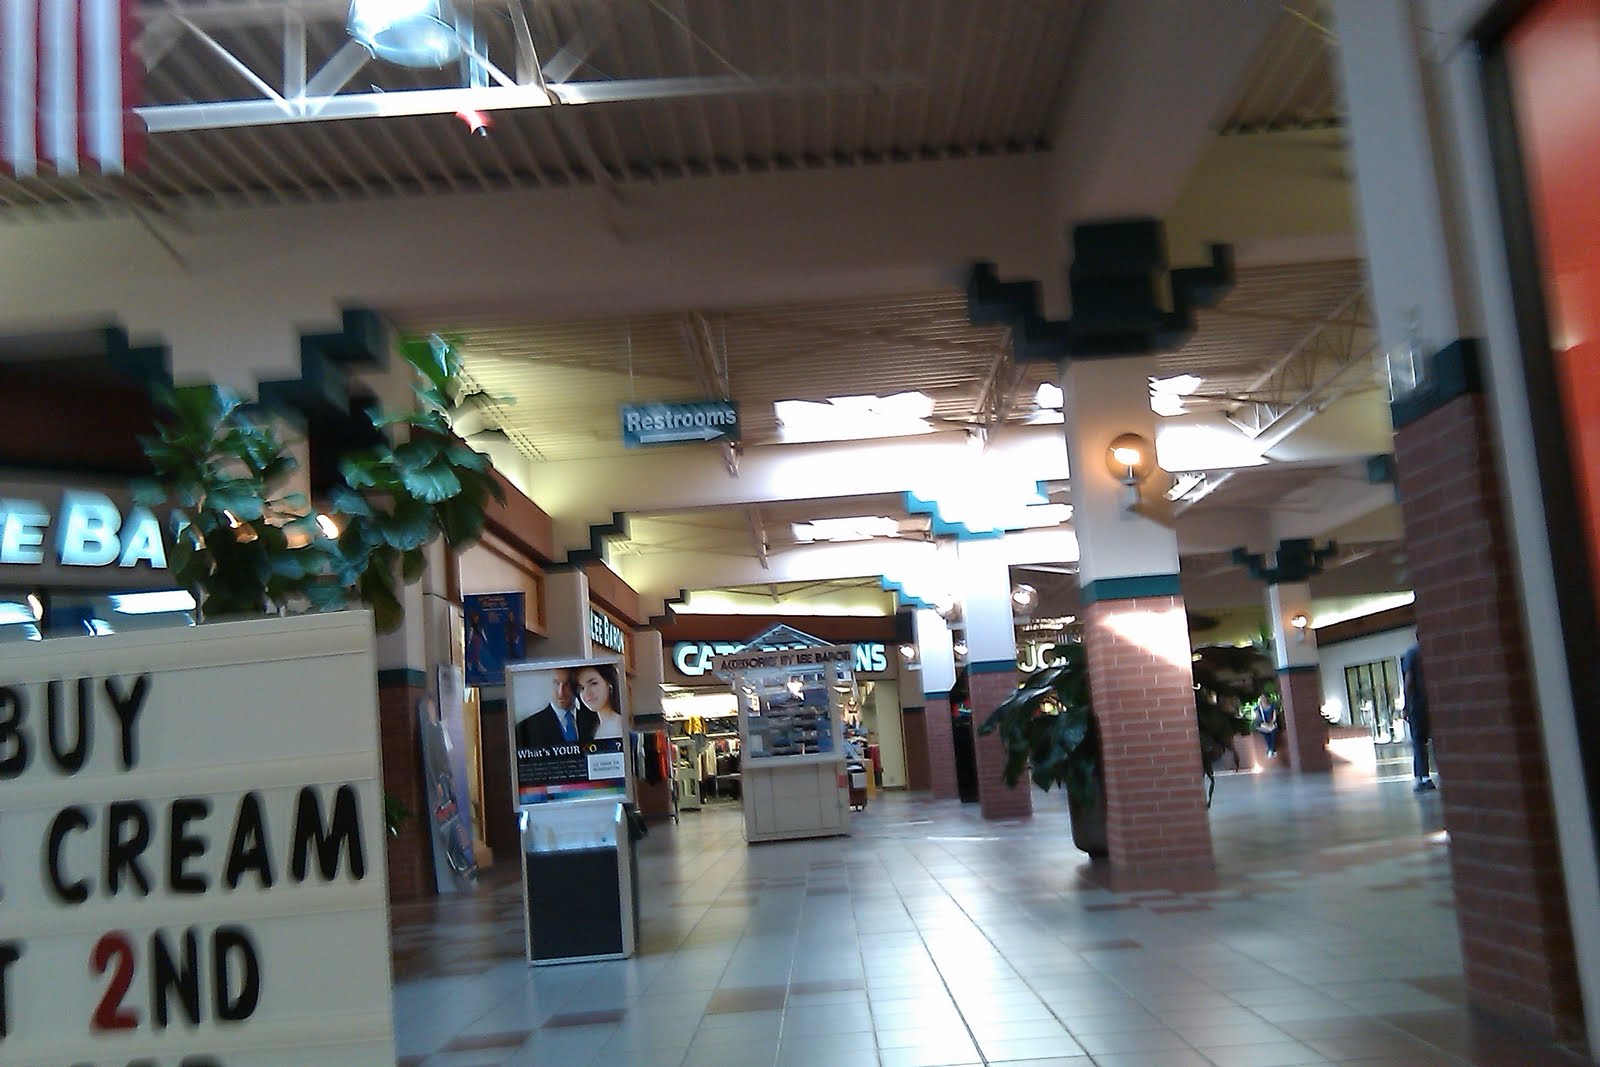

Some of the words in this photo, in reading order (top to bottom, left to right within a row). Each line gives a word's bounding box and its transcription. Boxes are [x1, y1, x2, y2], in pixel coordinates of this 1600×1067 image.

[626, 409, 738, 432] Restrooms
[58, 490, 207, 570] BA
[590, 608, 603, 645] LEE
[674, 641, 742, 676] CA
[1016, 640, 1069, 673] JC
[0, 673, 151, 780] BUY
[518, 749, 551, 759] What's
[552, 745, 581, 756] YOUR
[46, 784, 366, 905] CREAM
[90, 925, 261, 1031] 2ND
